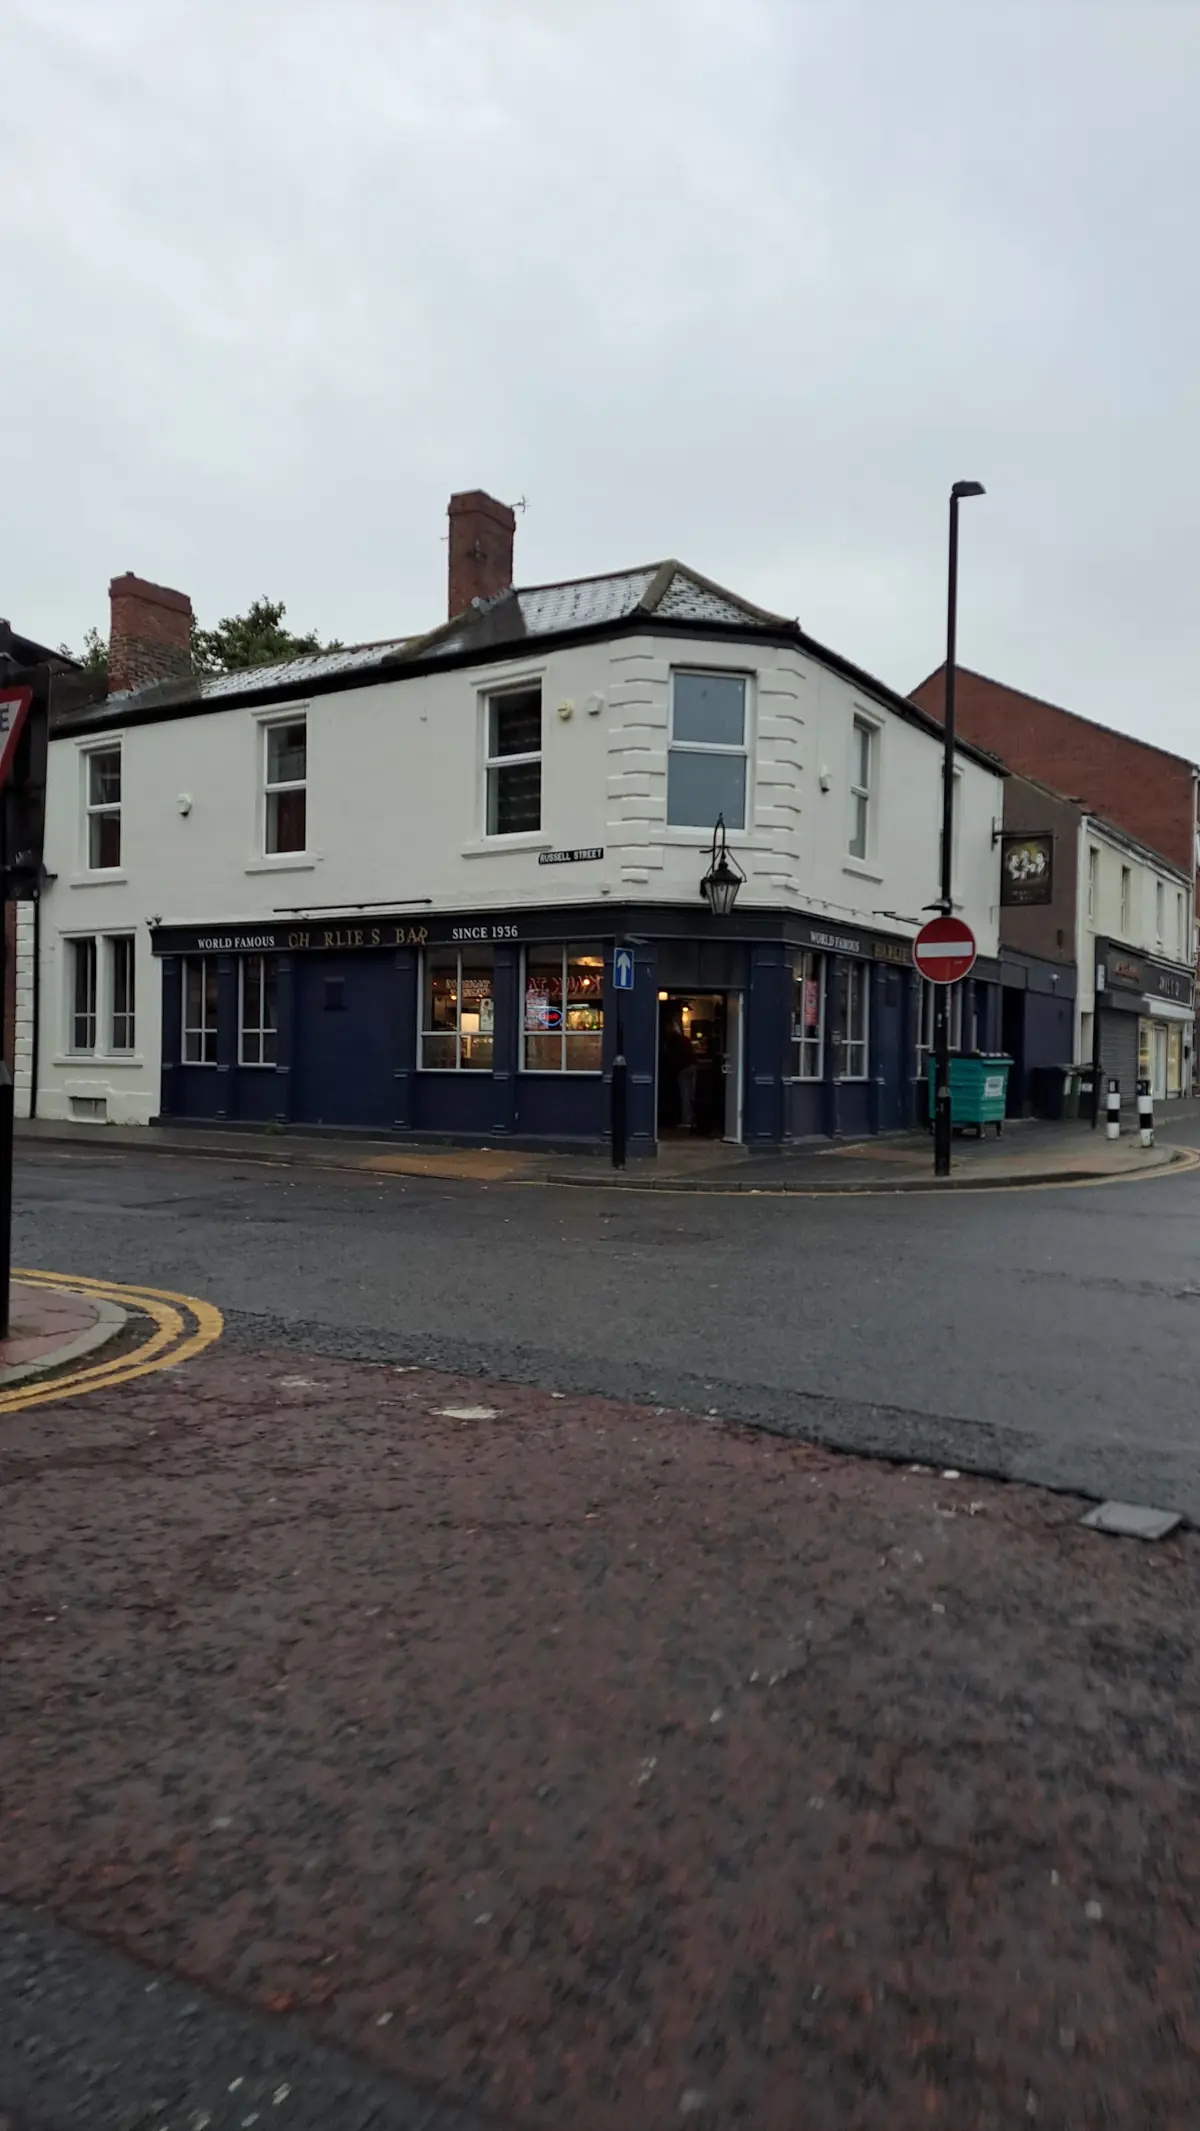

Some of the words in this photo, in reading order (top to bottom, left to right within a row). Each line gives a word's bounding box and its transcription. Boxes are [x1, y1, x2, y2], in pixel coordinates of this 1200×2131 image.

[540, 852, 572, 863] RUSSELL
[574, 849, 602, 860] STREET
[197, 937, 232, 949] WORLD
[234, 935, 275, 948] FAMOUS
[395, 925, 429, 946] BAR
[452, 926, 488, 940] SINCE
[491, 925, 519, 938] 1936
[810, 931, 834, 946] WORLD
